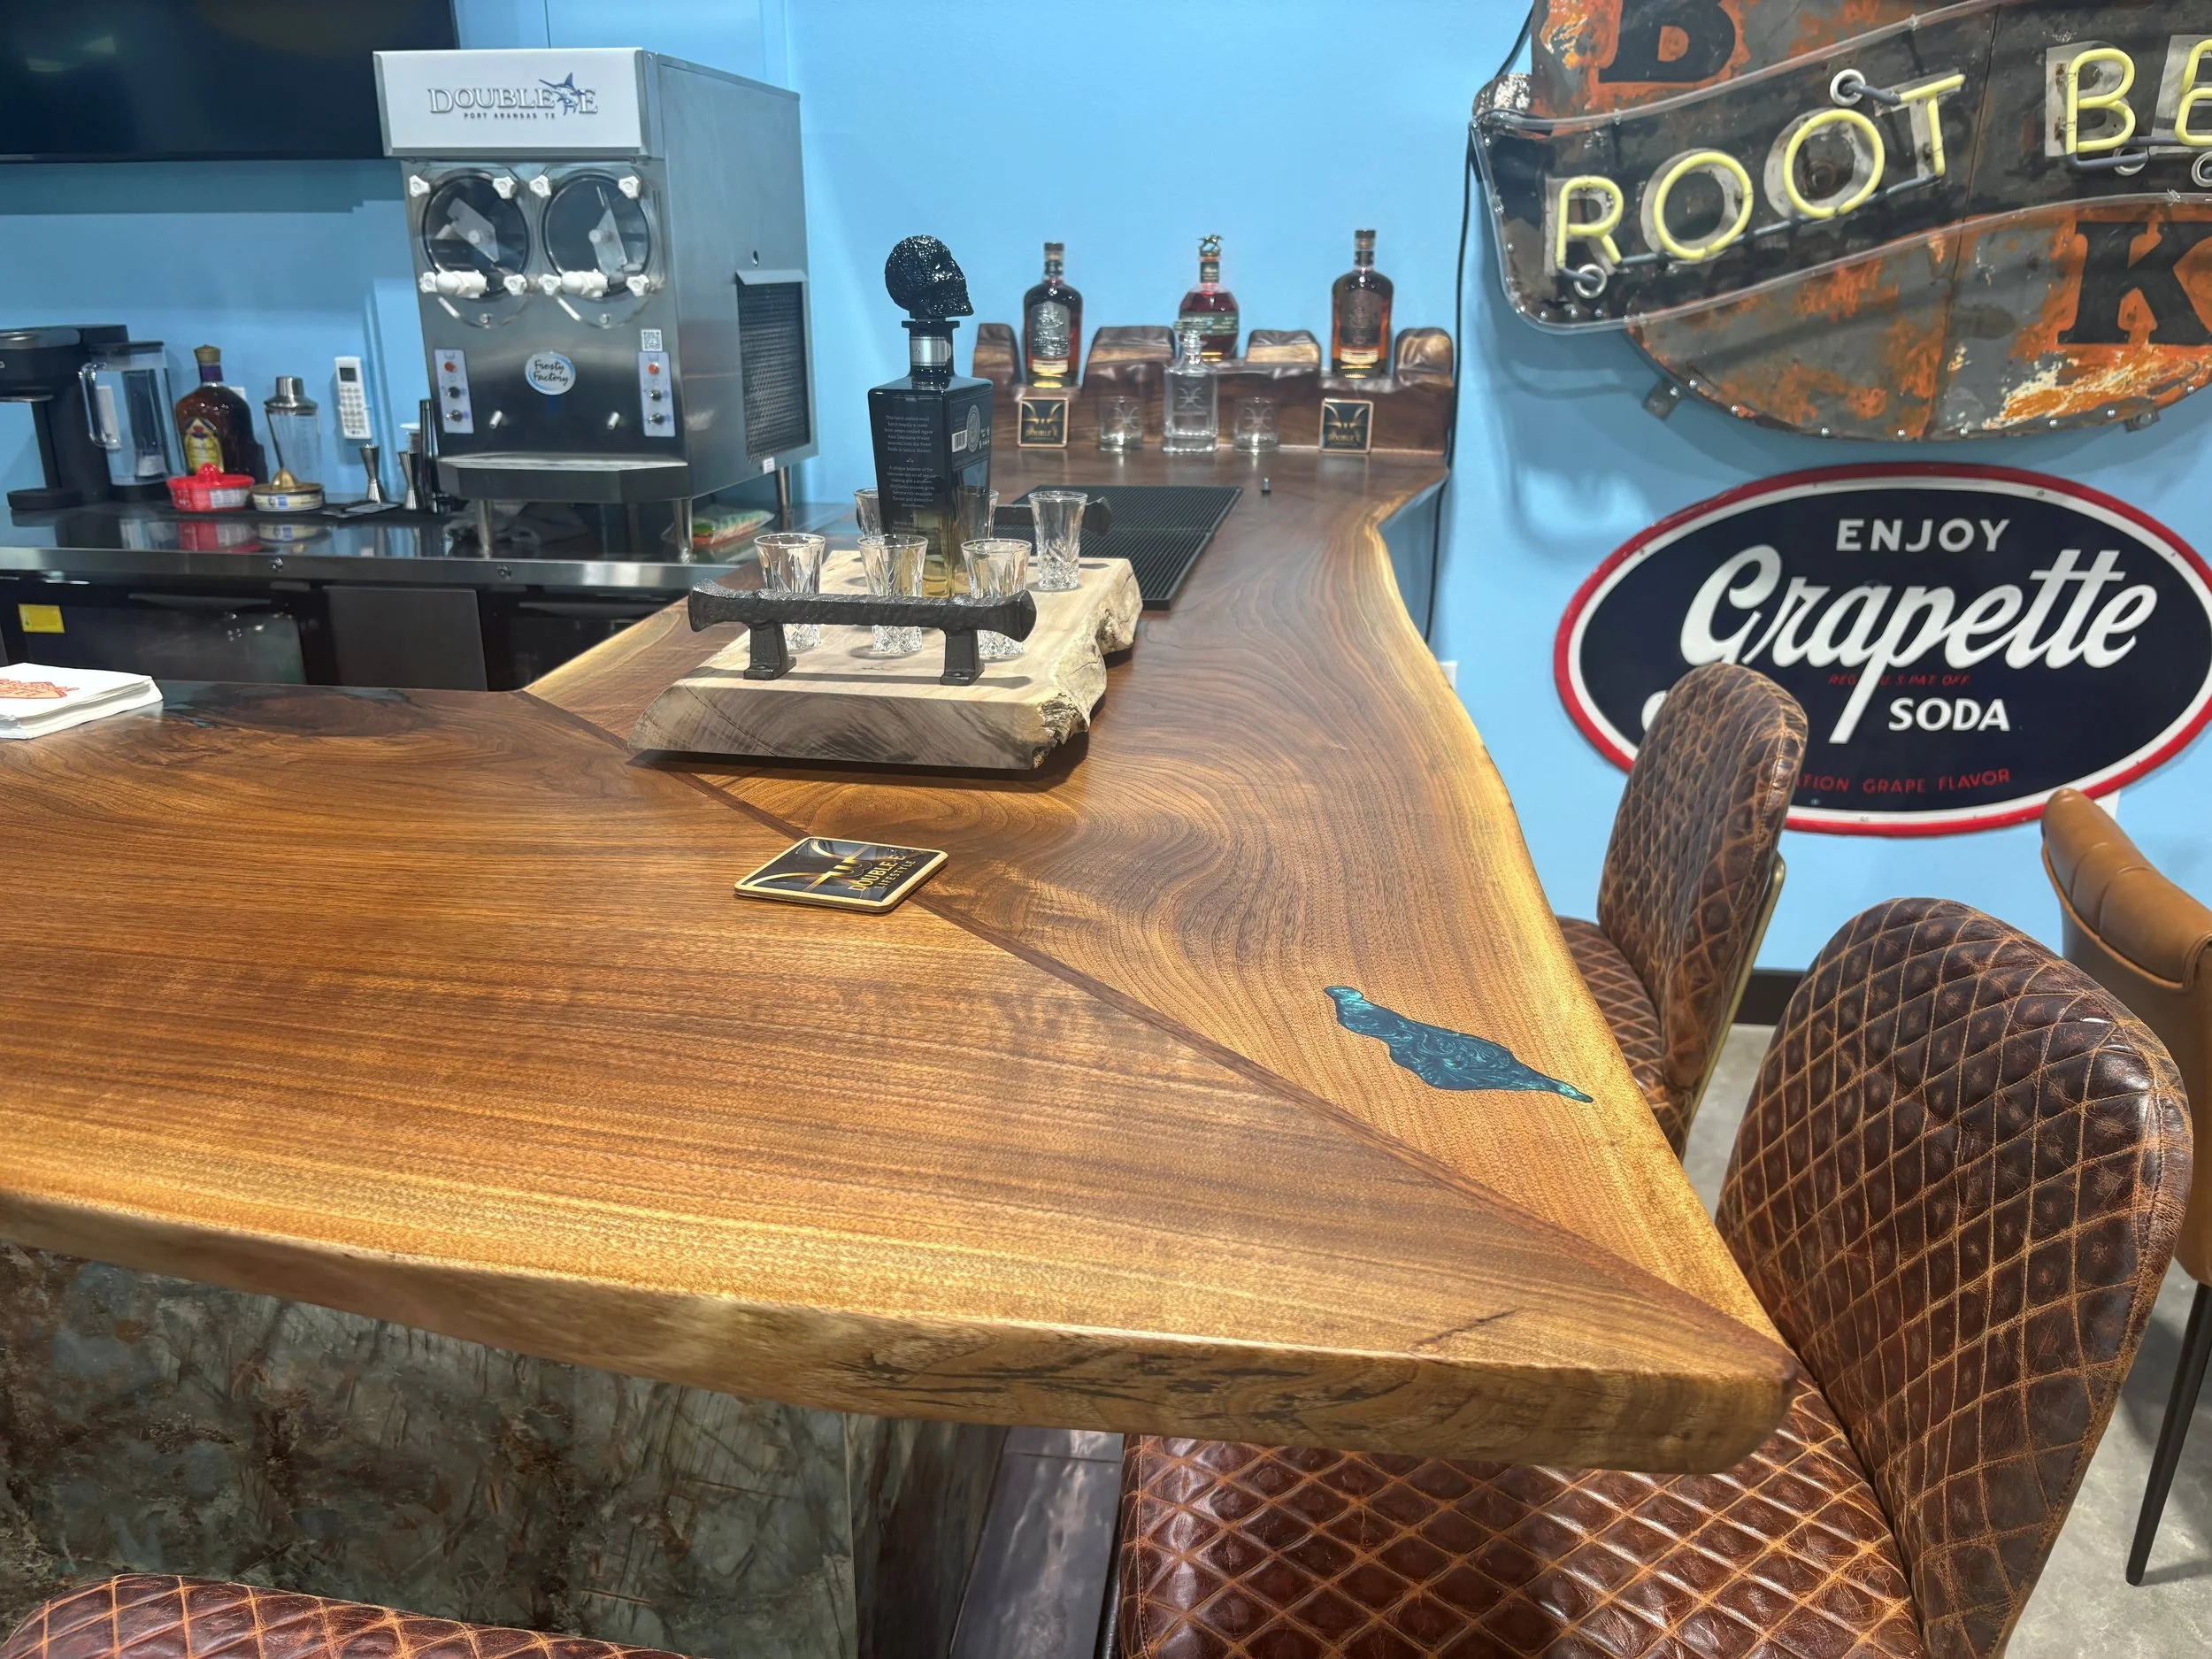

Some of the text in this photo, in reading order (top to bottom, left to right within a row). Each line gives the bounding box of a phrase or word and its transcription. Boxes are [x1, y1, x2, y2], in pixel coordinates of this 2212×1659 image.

[427, 88, 555, 114] DOUBLE
[1545, 73, 1966, 274] ROOT
[534, 359, 565, 375] Frosty
[534, 371, 569, 387] Factory
[1835, 518, 2010, 553] ENJOY
[1679, 544, 2158, 744] Grapette
[1888, 696, 2011, 732] SODA
[1796, 767, 2012, 795] TION GRAPE FLAVOR
[847, 861, 899, 892] DOUBLE
[873, 860, 917, 889] LIFESTYLE
